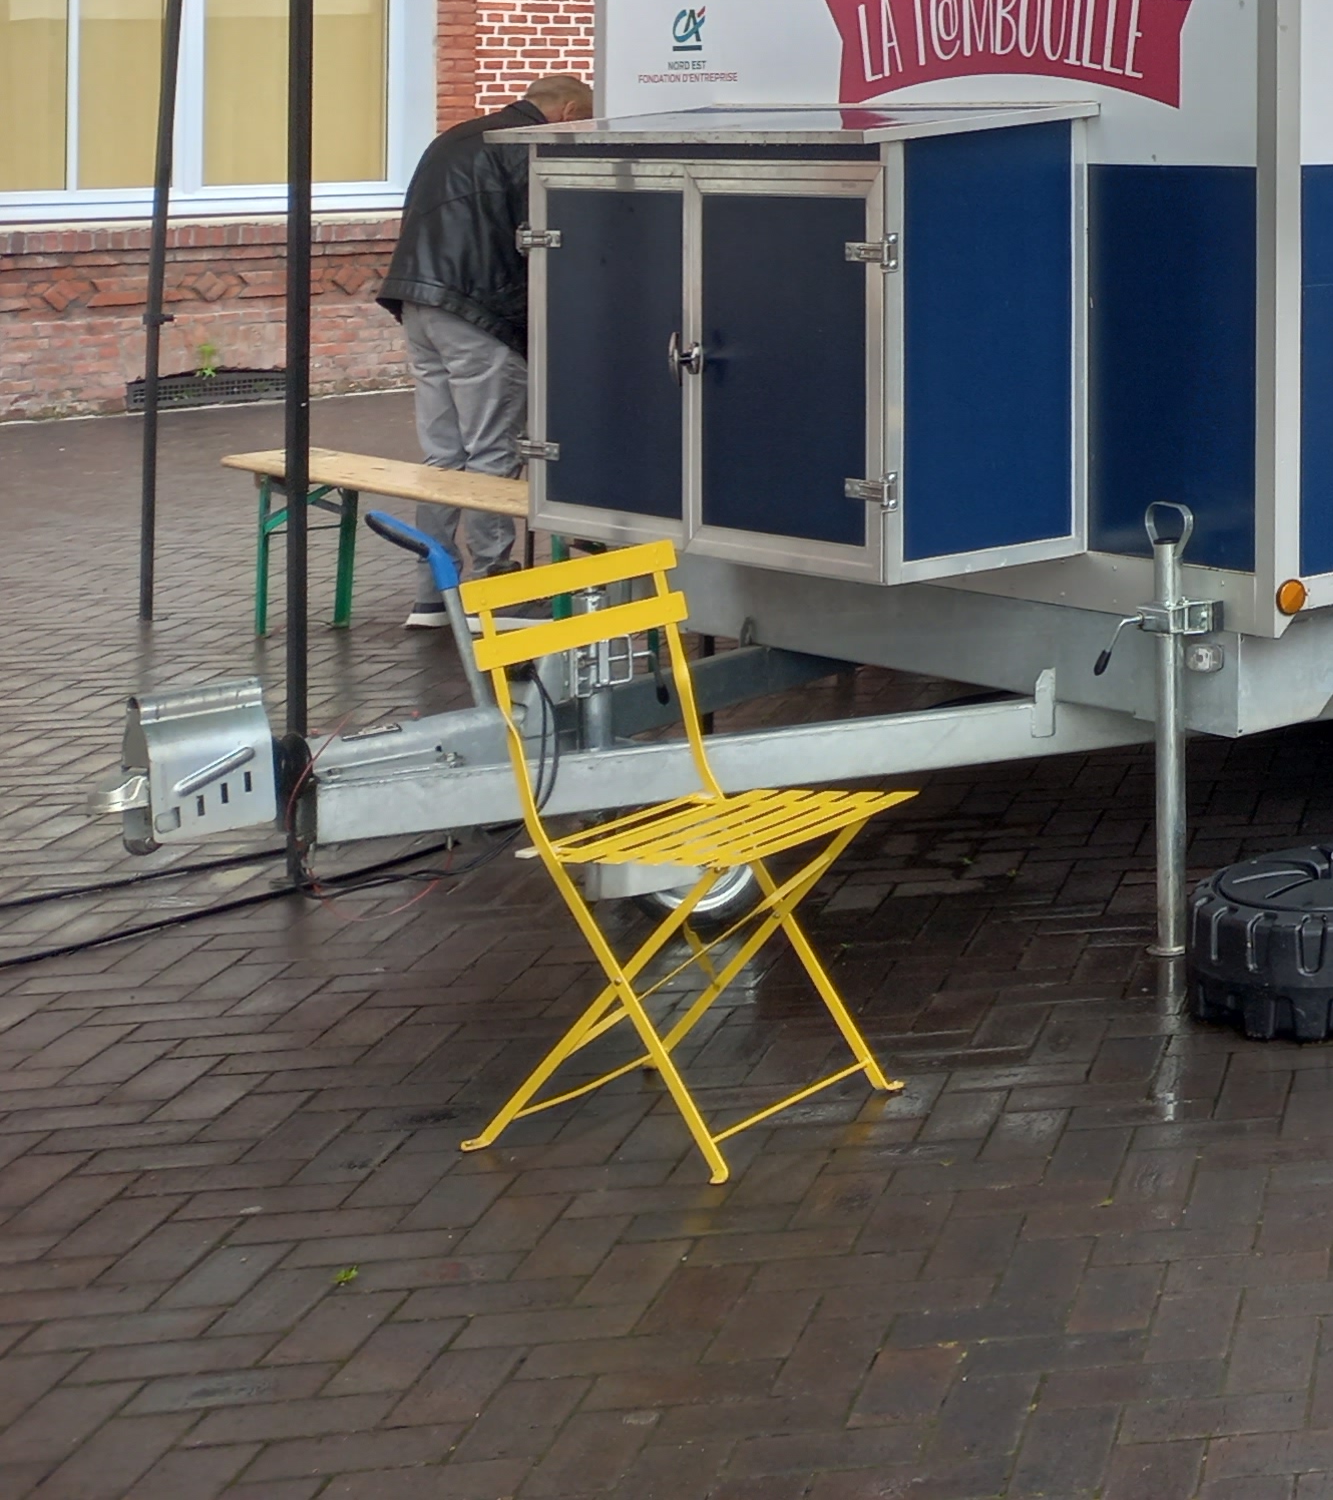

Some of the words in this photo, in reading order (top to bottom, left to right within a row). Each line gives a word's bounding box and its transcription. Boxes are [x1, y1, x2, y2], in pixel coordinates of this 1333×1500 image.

[668, 61, 690, 71] NORD
[691, 60, 707, 70] EST
[638, 73, 681, 84] FONDATION
[682, 72, 738, 83] D'ENTREPRISE
